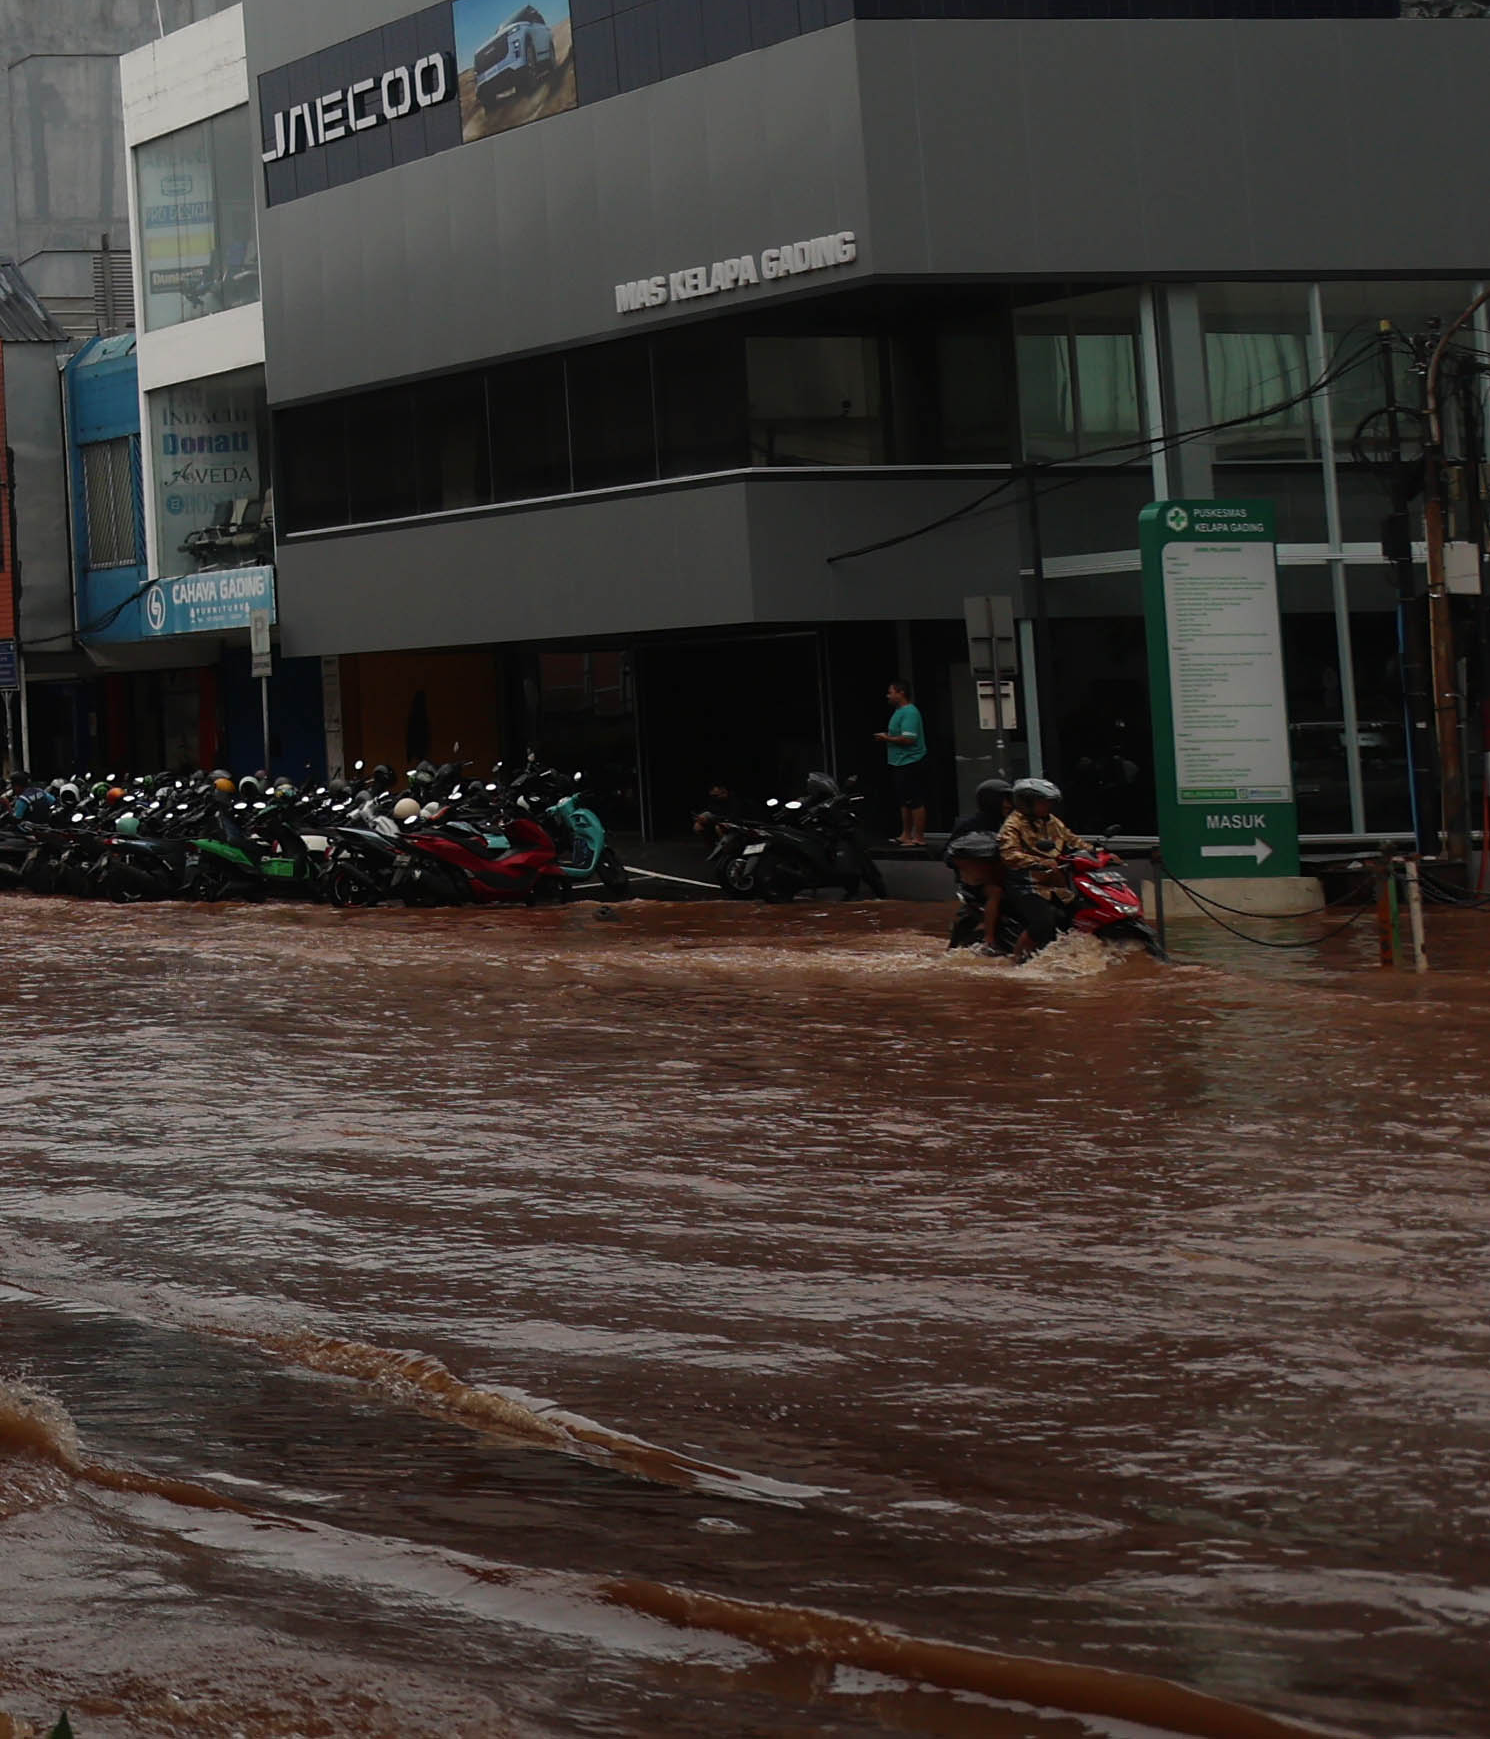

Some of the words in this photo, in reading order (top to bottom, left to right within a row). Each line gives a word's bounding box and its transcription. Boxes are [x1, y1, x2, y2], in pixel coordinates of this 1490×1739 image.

[262, 52, 447, 164] JAECOO
[614, 275, 668, 314] MAS
[669, 254, 761, 302] KELAPA
[760, 230, 858, 280] GADING
[162, 431, 249, 455] Donati
[1193, 508, 1248, 518] PUSKESMAS
[1193, 523, 1229, 532] KELAPA
[1229, 523, 1265, 533] GADING
[171, 581, 217, 605] CAHAYA
[219, 575, 265, 600] GADING
[1205, 813, 1267, 830] MASUK
